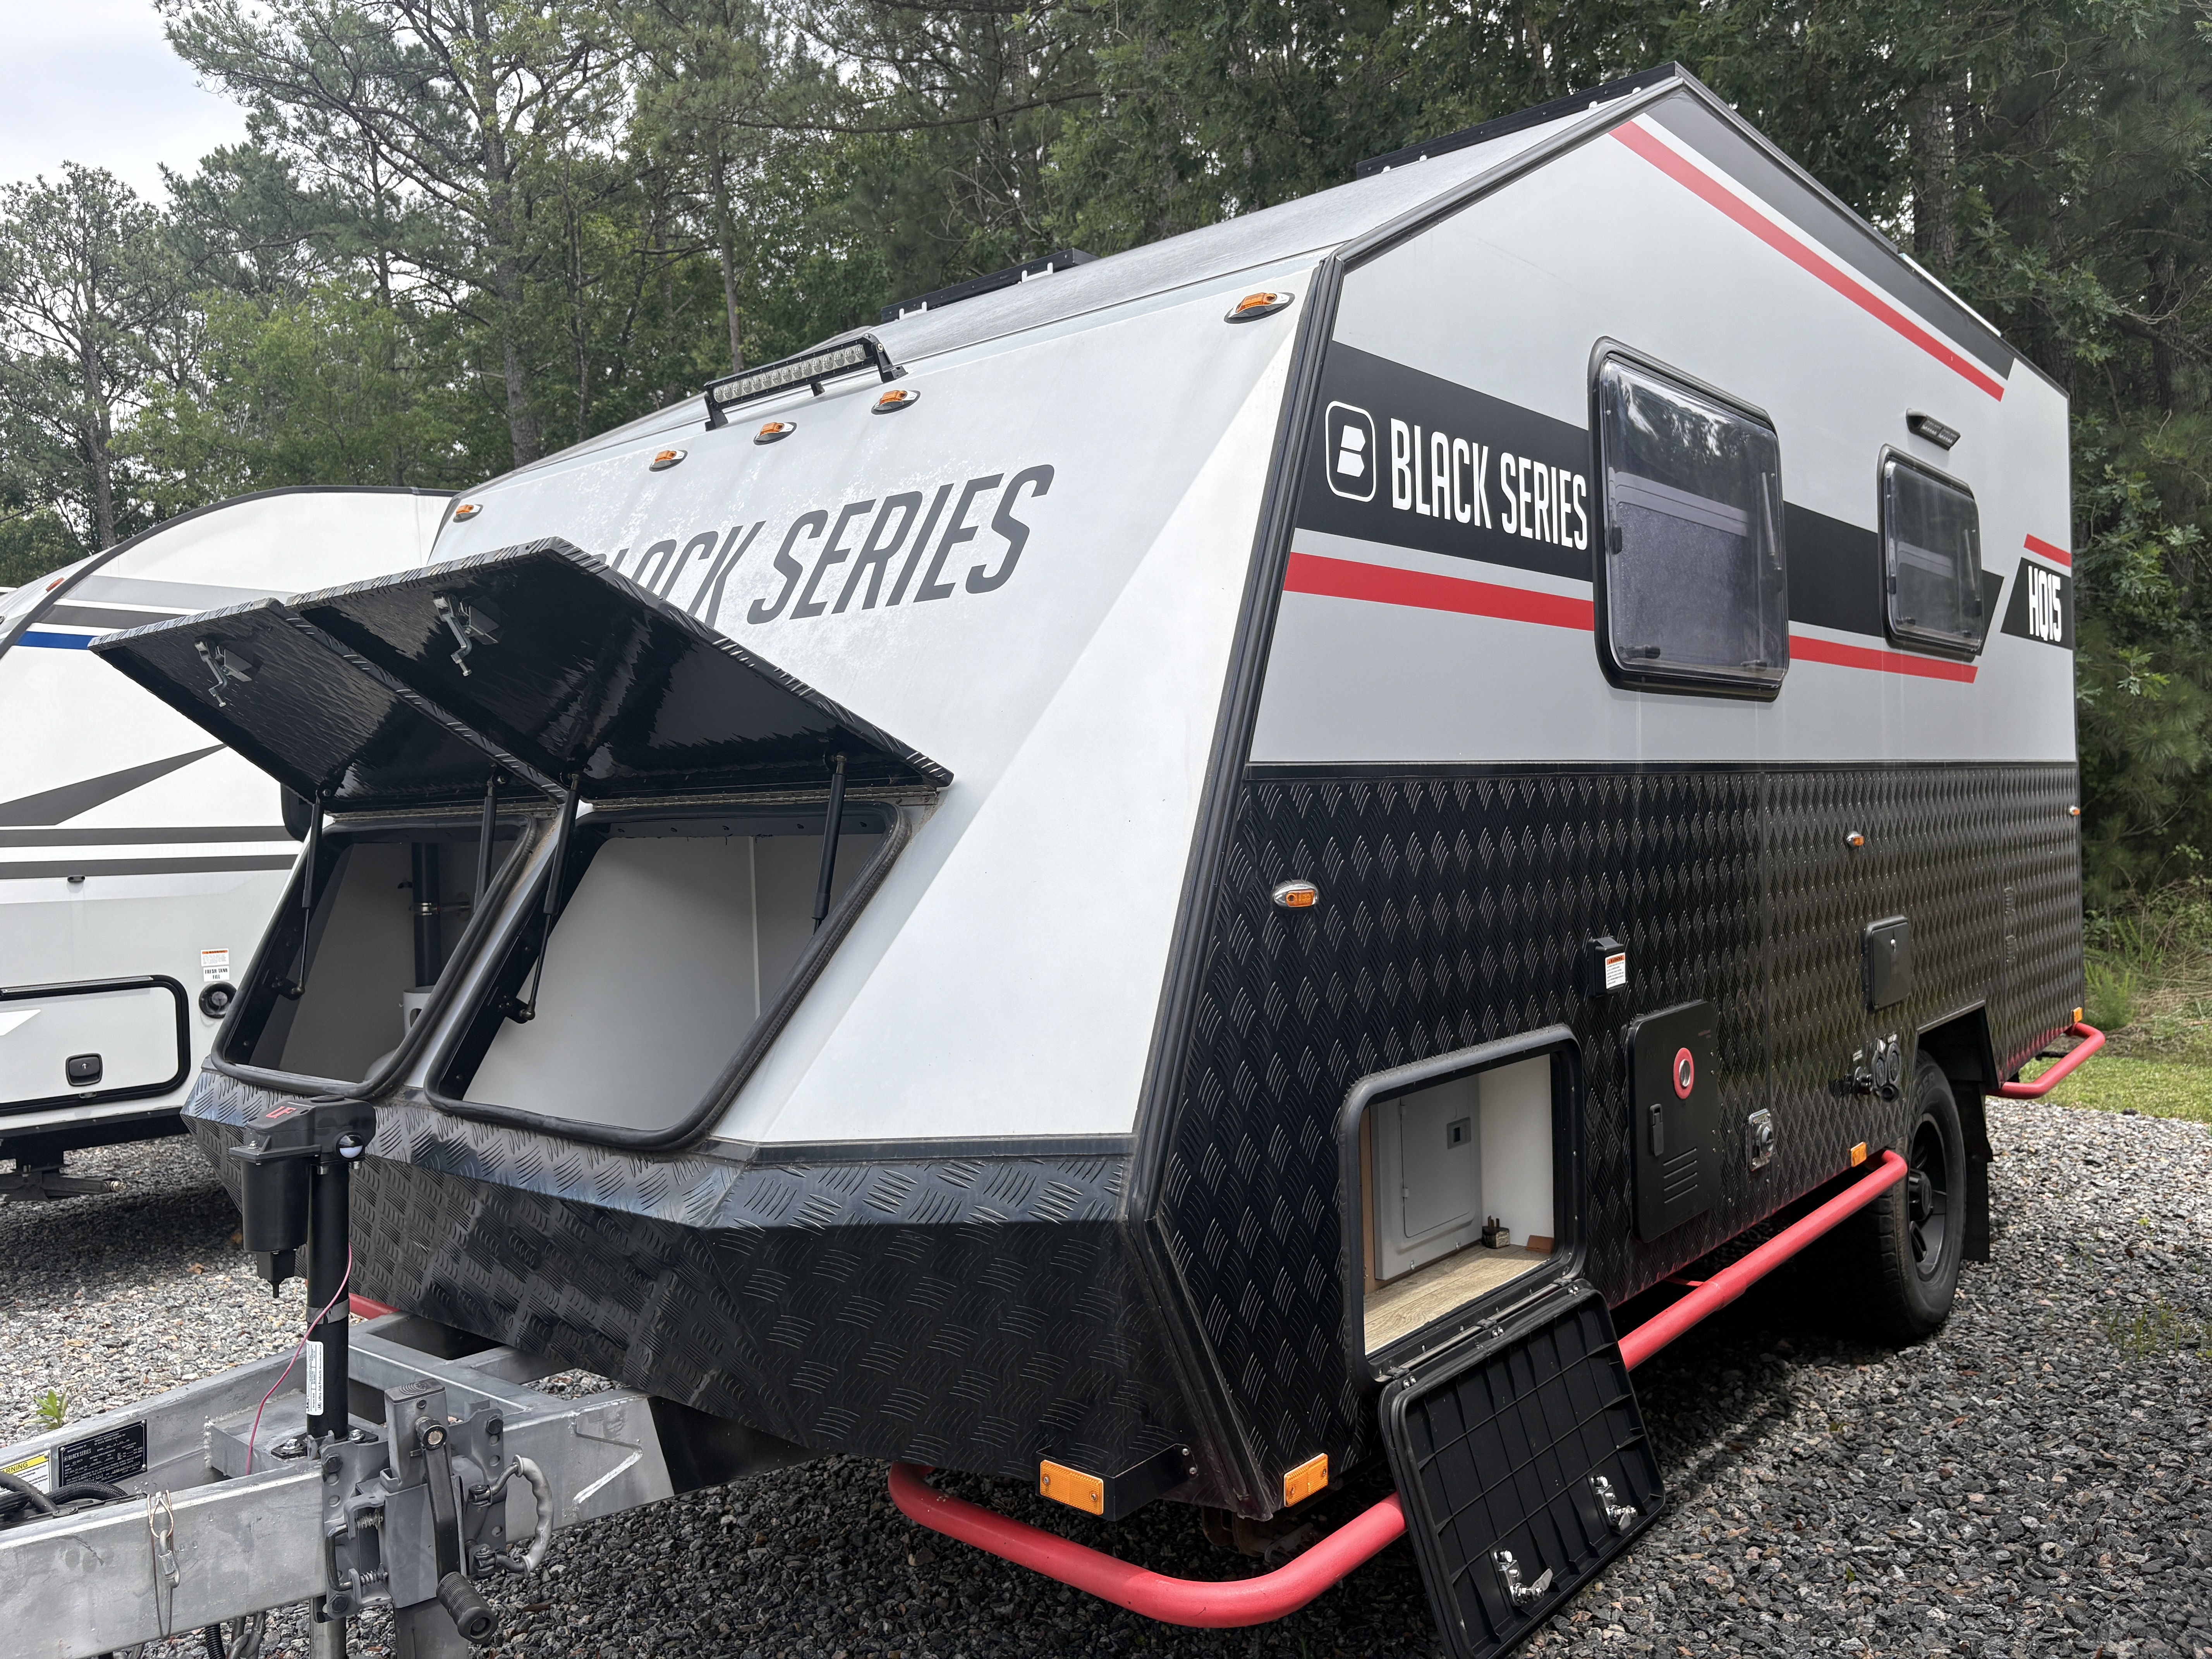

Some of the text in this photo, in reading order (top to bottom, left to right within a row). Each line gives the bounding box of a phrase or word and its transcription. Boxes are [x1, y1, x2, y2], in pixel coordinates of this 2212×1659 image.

[1391, 418, 1492, 529] BLACK
[1500, 452, 1587, 550] SERIES
[747, 465, 1054, 625] SERIES
[2028, 565, 2062, 642] HQ15
[2, 1462, 28, 1473] RNING
[68, 1452, 79, 1460] BLACK
[79, 1448, 91, 1456] SERIES
